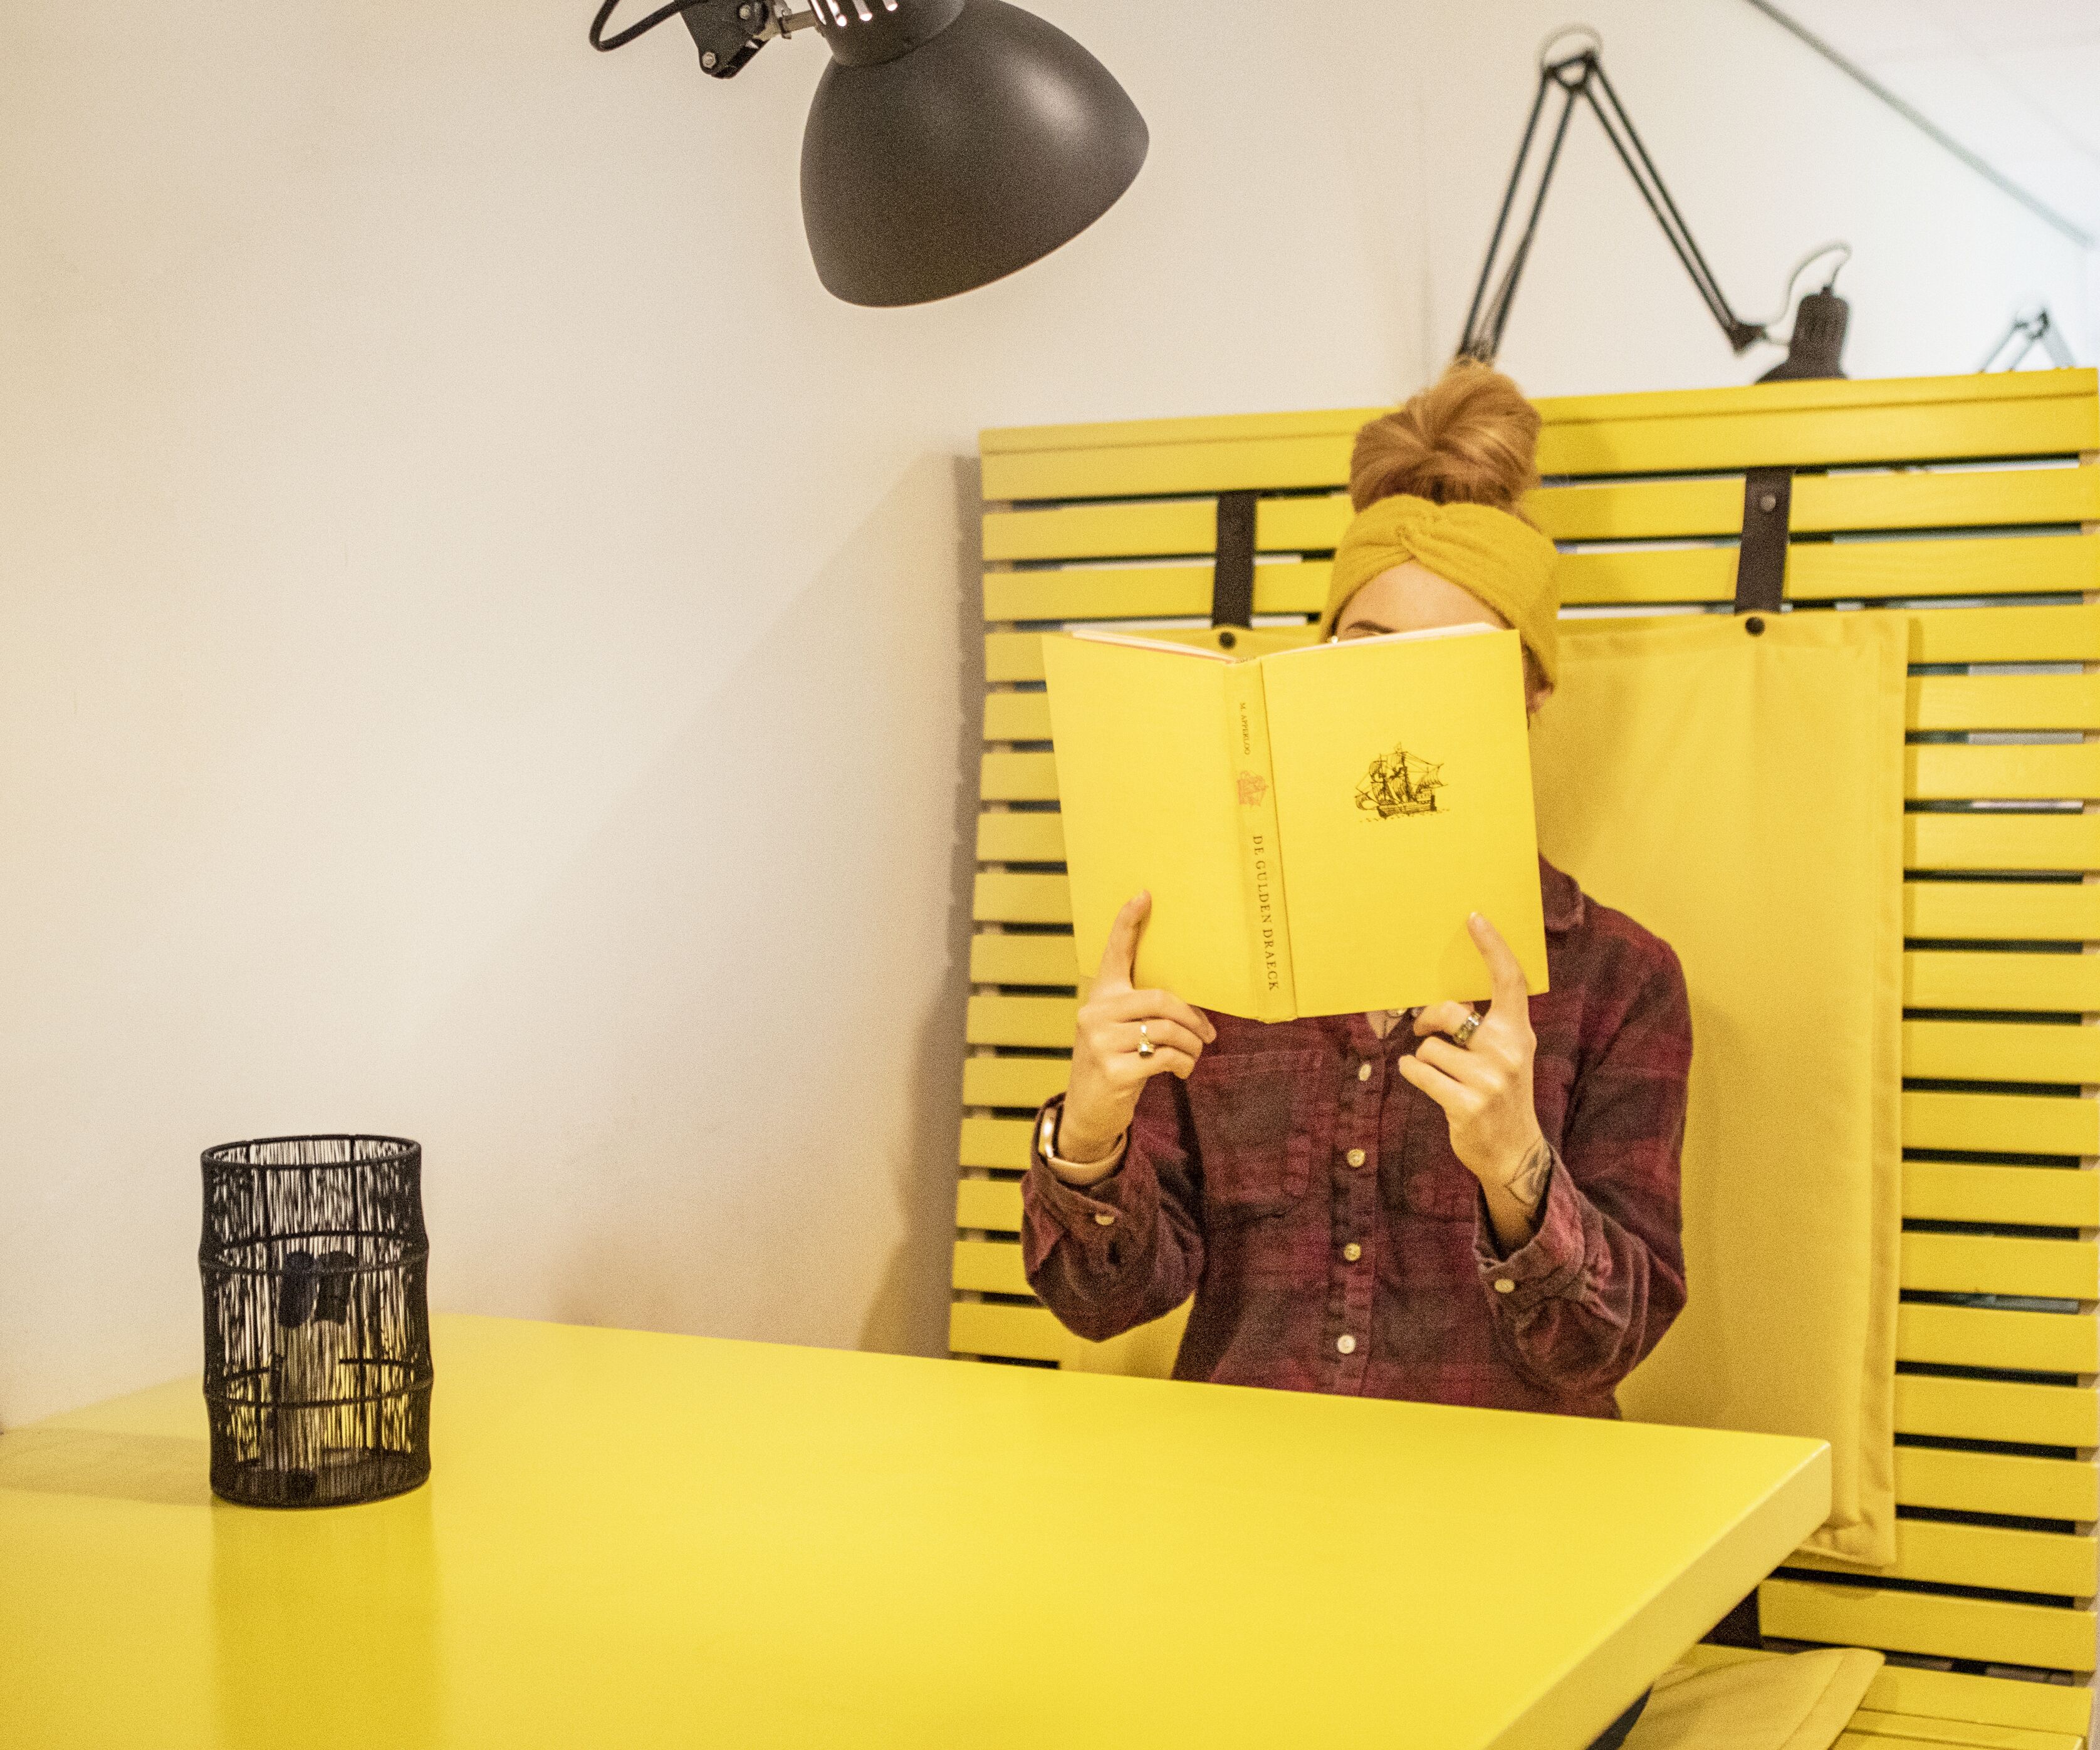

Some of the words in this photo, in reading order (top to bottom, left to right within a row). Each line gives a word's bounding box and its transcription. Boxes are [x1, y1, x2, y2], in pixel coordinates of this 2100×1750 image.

[1253, 835, 1264, 855] DE
[1256, 860, 1272, 923] GULDEN
[1263, 929, 1279, 991] DRAECK
